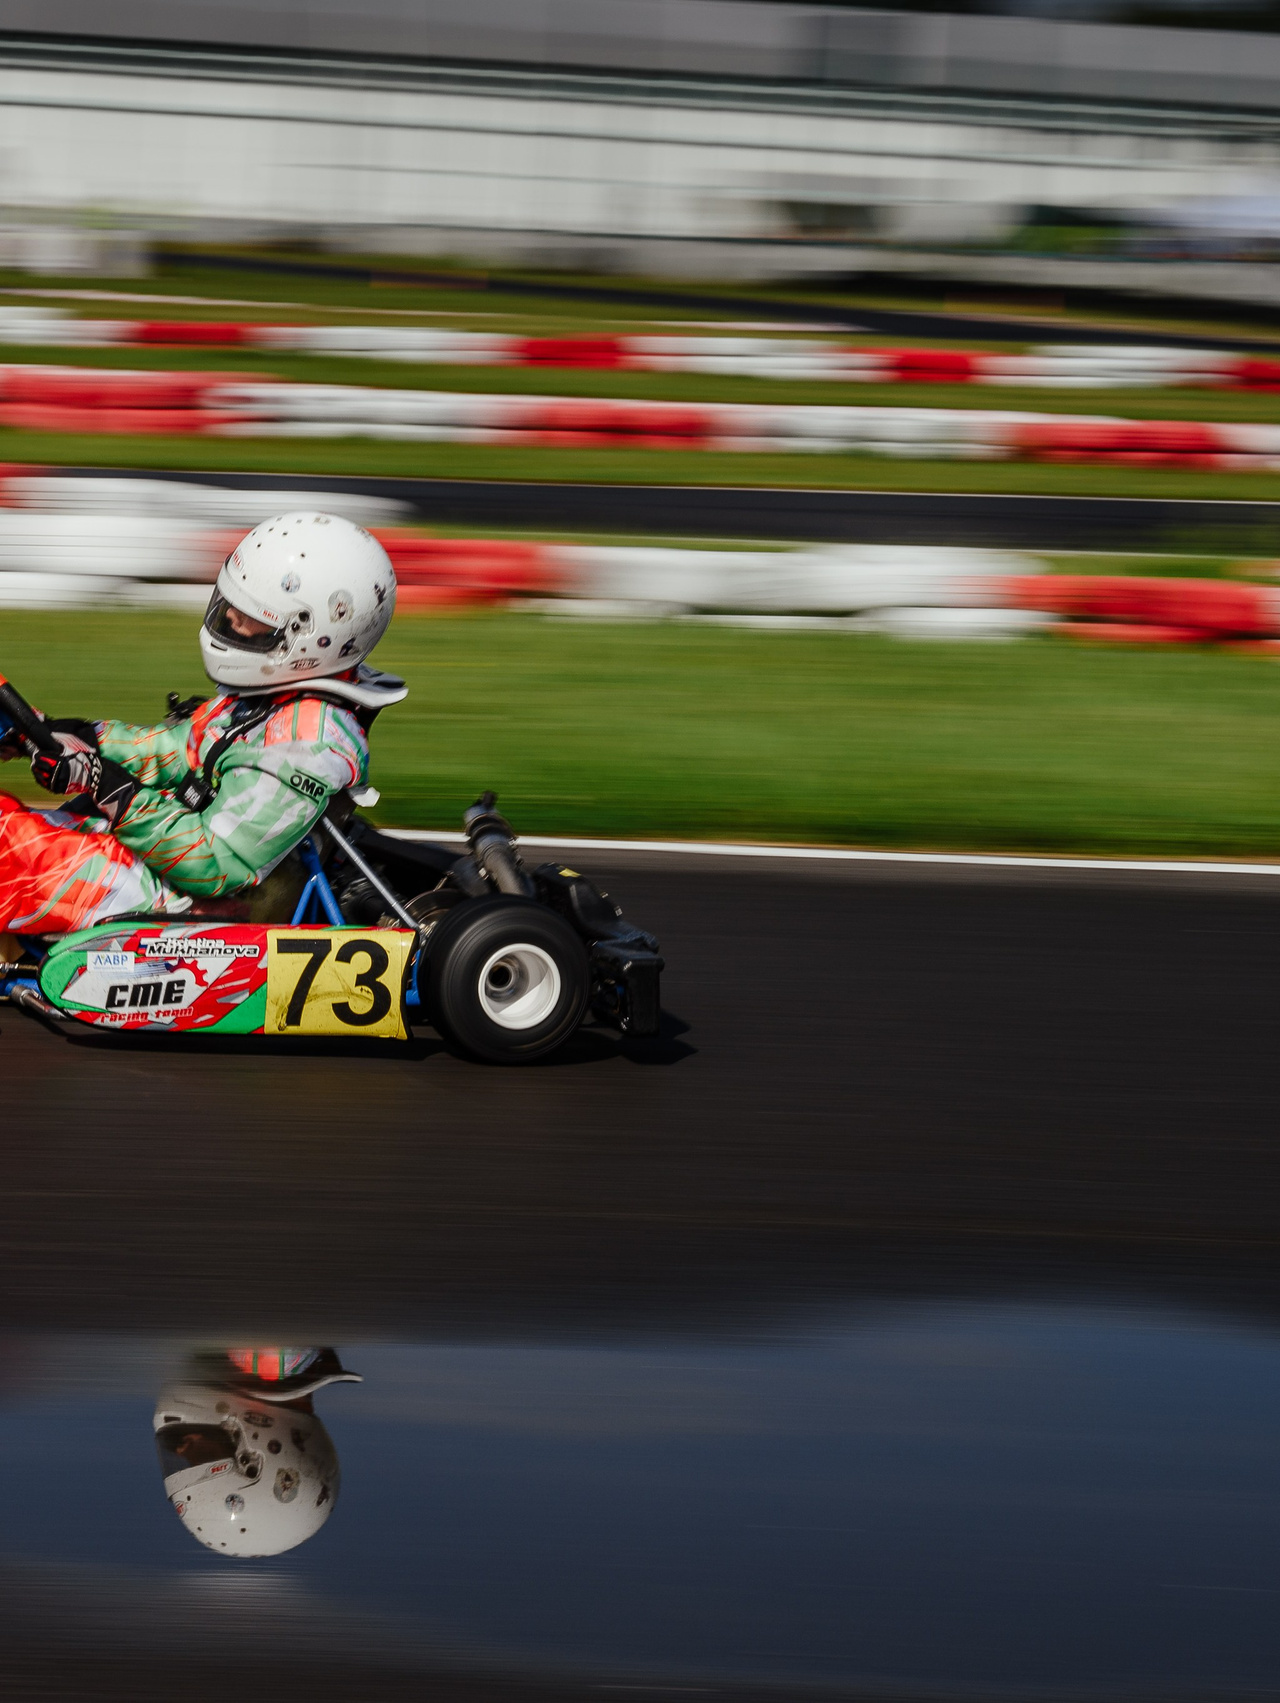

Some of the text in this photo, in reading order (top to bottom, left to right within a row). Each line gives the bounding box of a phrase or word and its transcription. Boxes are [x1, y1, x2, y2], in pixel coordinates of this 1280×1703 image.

[290, 774, 325, 798] OMP
[147, 944, 260, 957] Mukhanova
[105, 979, 187, 1009] CME
[276, 938, 392, 1027] 73
[99, 1006, 194, 1024] racing team
